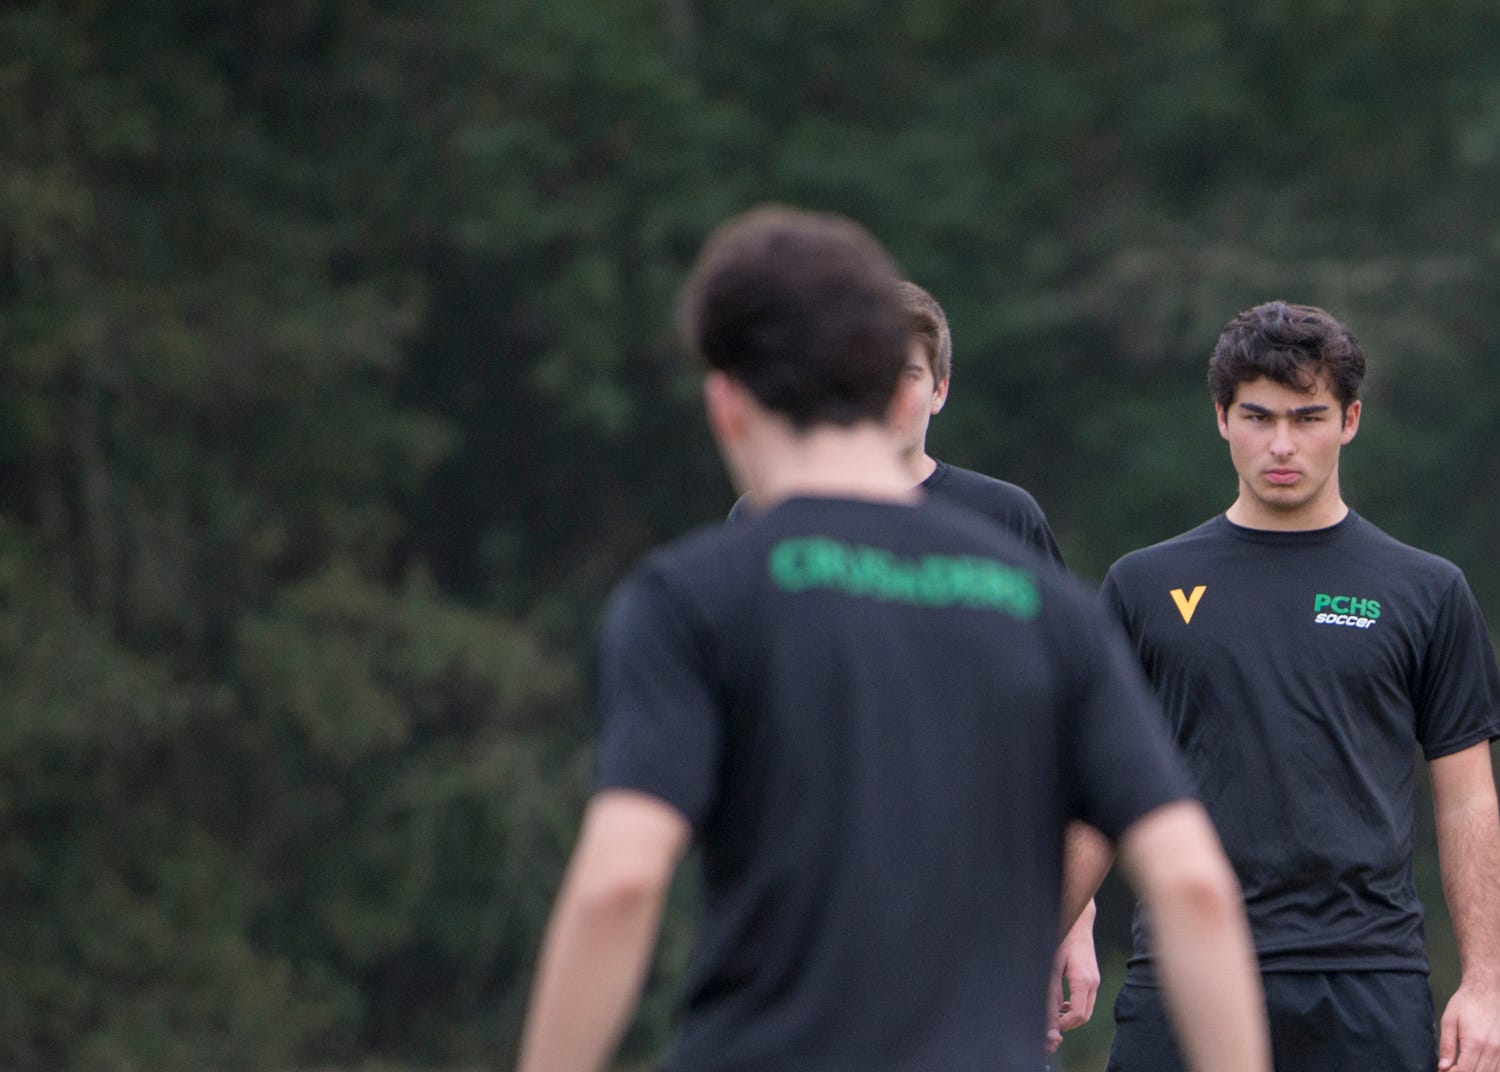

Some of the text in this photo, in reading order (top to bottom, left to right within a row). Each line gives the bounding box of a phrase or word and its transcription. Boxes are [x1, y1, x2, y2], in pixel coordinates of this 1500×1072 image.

[1169, 585, 1207, 624] V
[1314, 593, 1381, 619] PCHS
[1314, 612, 1376, 628] soccer
